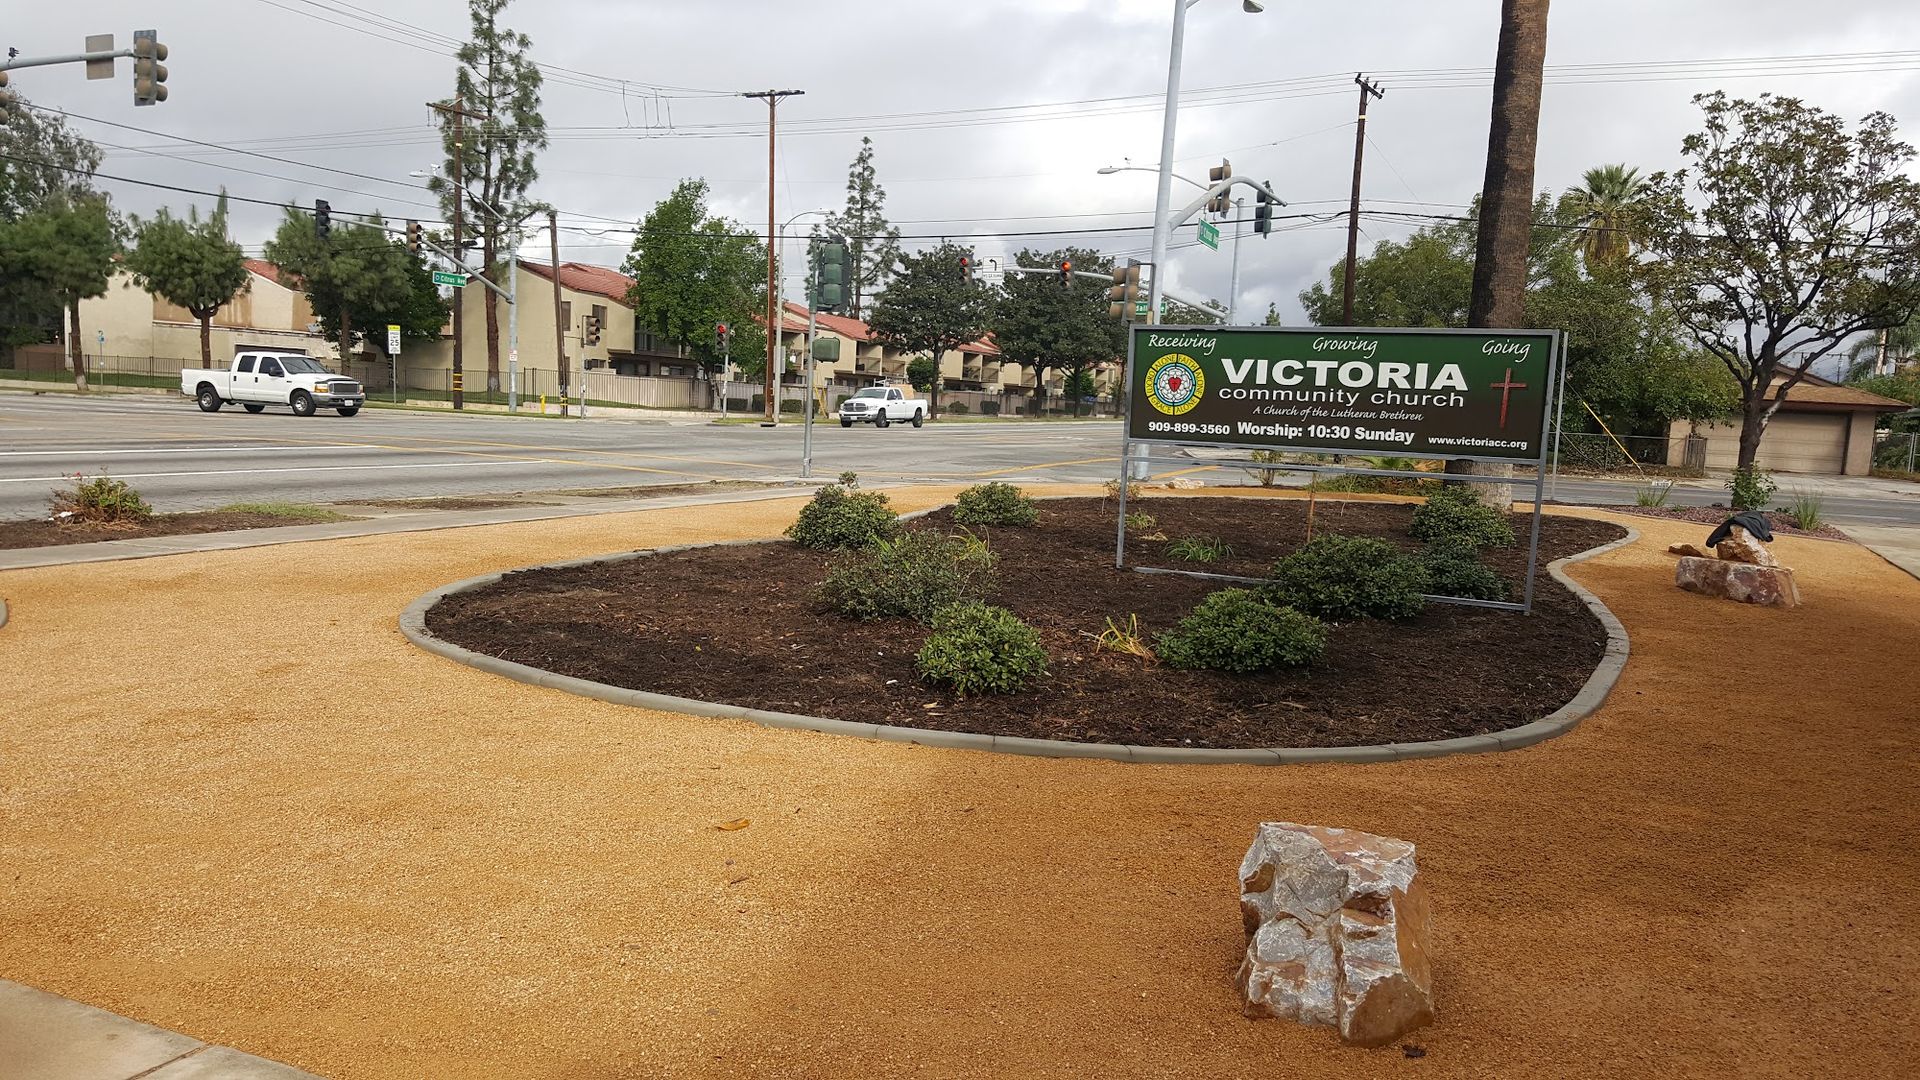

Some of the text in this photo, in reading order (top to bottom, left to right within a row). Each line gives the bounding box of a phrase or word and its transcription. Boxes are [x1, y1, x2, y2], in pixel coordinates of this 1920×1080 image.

[390, 339, 400, 347] 25
[1148, 333, 1216, 356] Receiving
[1312, 336, 1378, 359] Growing
[1481, 339, 1531, 363] Going
[1178, 354, 1198, 370] FAITH
[1220, 358, 1468, 391] VICTORIA
[1218, 386, 1464, 408] community church
[1252, 405, 1424, 422] A Church of the Lutheran Brethren
[1148, 421, 1231, 435] 909-899-3560
[1237, 422, 1415, 445] Worship: 10:30 Sunday
[1428, 436, 1528, 450] www.victoriacc.org
